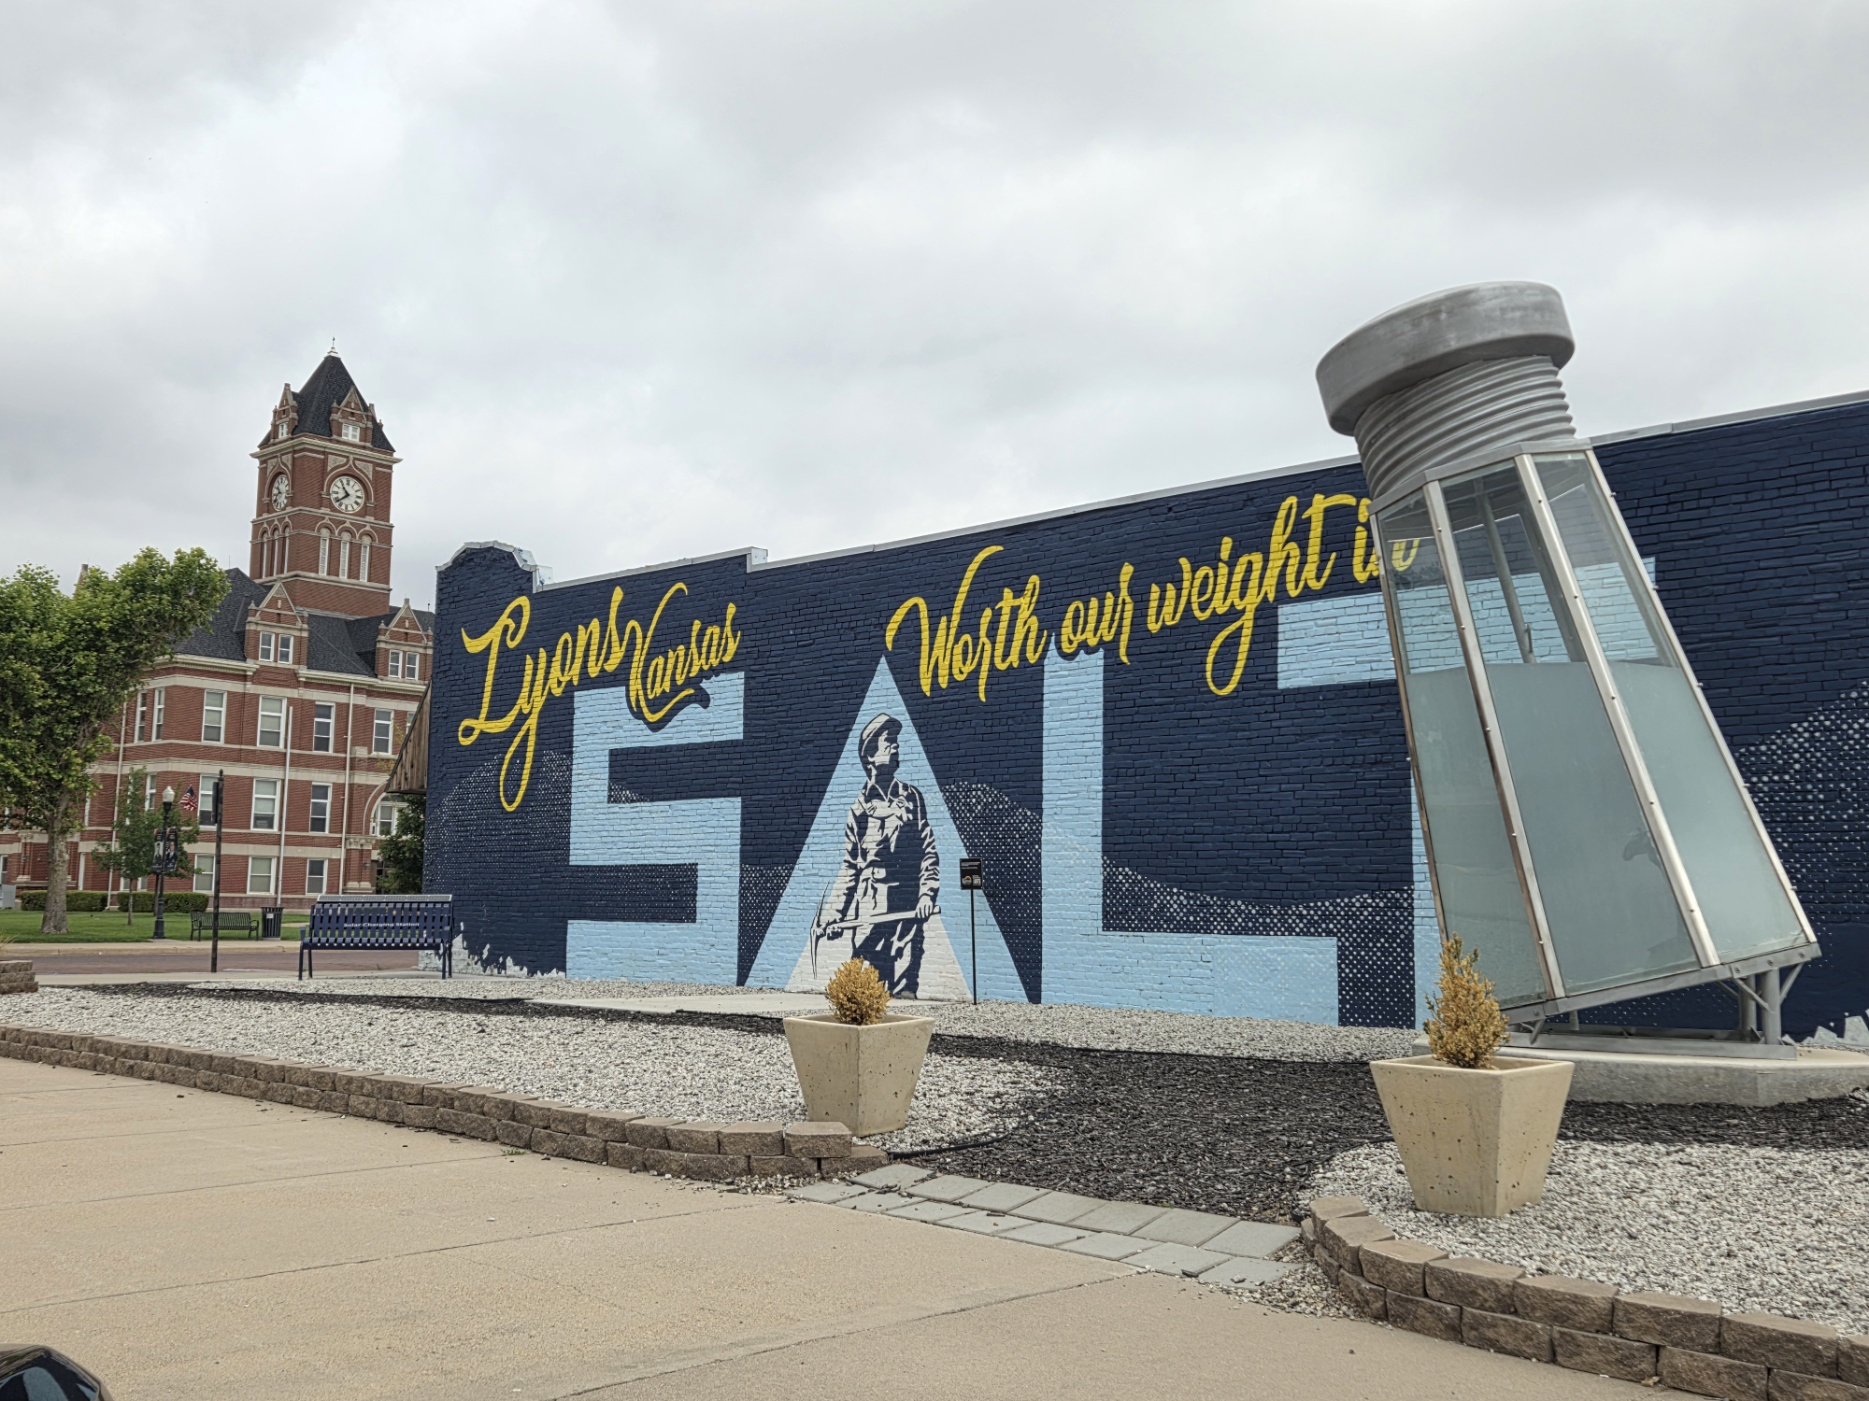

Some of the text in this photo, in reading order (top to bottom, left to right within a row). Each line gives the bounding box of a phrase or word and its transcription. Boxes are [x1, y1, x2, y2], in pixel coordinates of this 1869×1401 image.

[457, 582, 741, 812] Lyons Kansas
[885, 545, 1047, 703] Worth
[1060, 561, 1135, 665] our
[1146, 493, 1358, 696] weight
